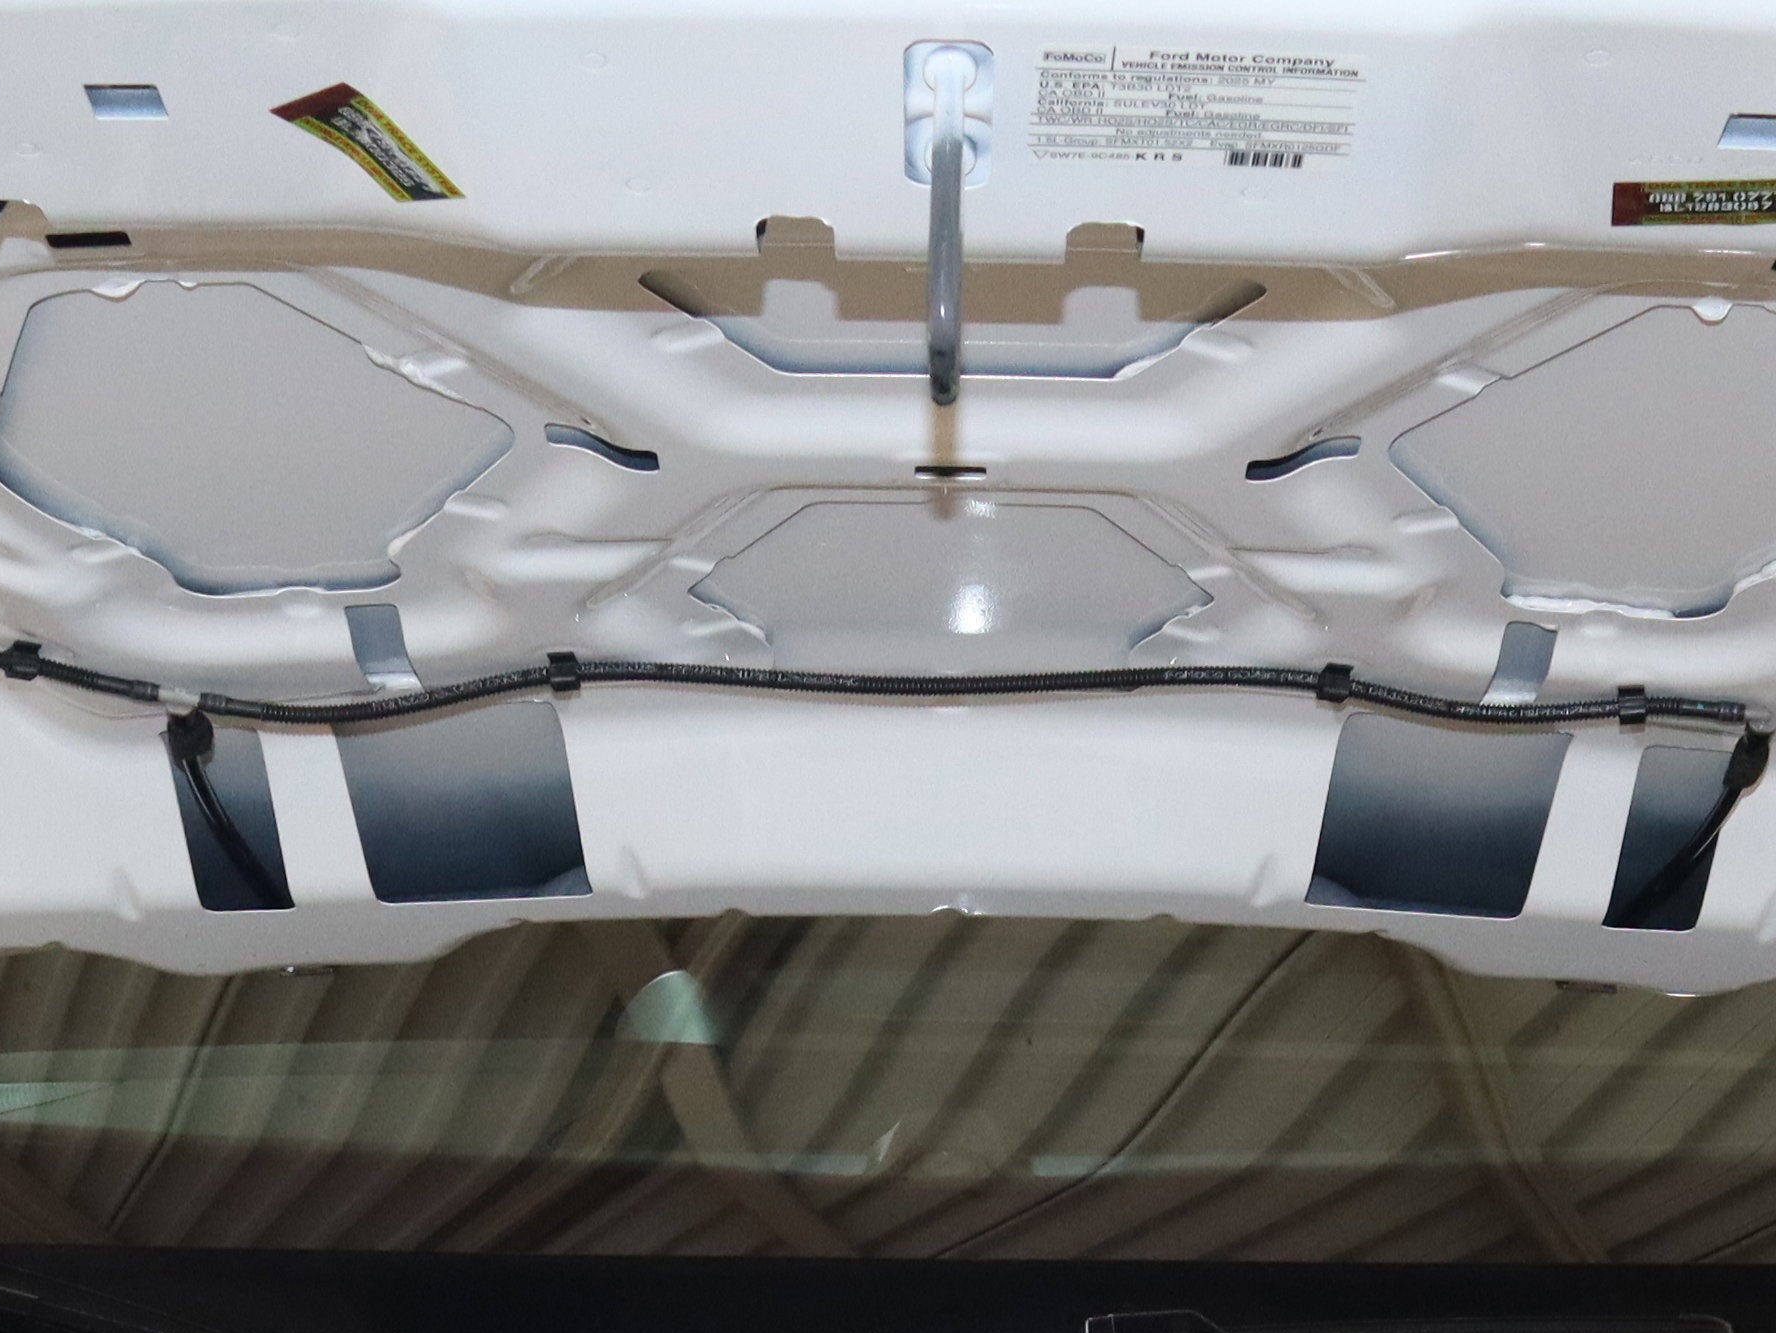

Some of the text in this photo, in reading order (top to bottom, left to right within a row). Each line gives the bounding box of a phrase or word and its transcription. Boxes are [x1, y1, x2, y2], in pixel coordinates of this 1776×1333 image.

[1045, 52, 1104, 63] FoMoCo
[1149, 51, 1335, 68] Ford Motor Company
[1122, 61, 1359, 78] VEHICLE EMISSION CONTROL INFORMATION
[1040, 71, 1109, 80] Conforms
[1215, 131, 1262, 140] needed
